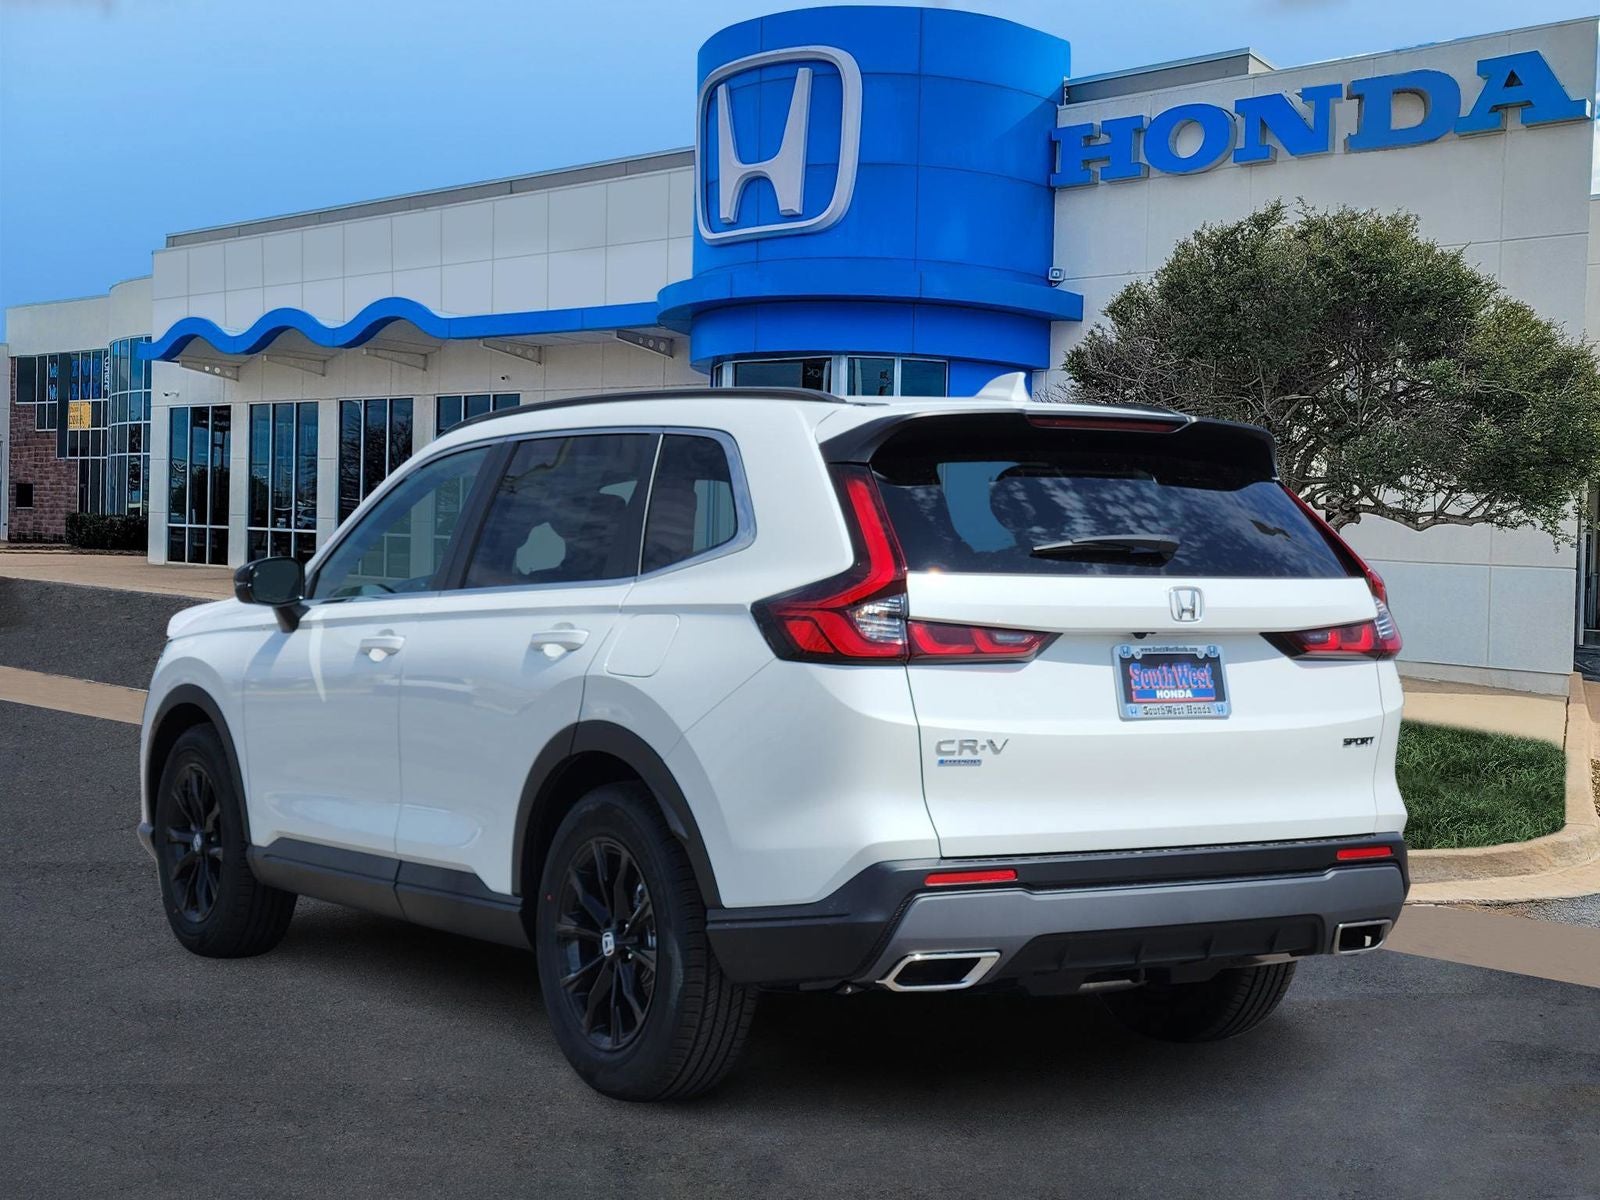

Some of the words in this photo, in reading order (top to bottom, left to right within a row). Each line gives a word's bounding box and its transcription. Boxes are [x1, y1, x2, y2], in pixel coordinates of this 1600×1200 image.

[1050, 50, 1591, 187] HONDA
[1156, 689, 1193, 698] HONDA
[1186, 704, 1212, 714] Honda
[935, 738, 1008, 756] CR-V
[1343, 736, 1374, 747] SPORT
